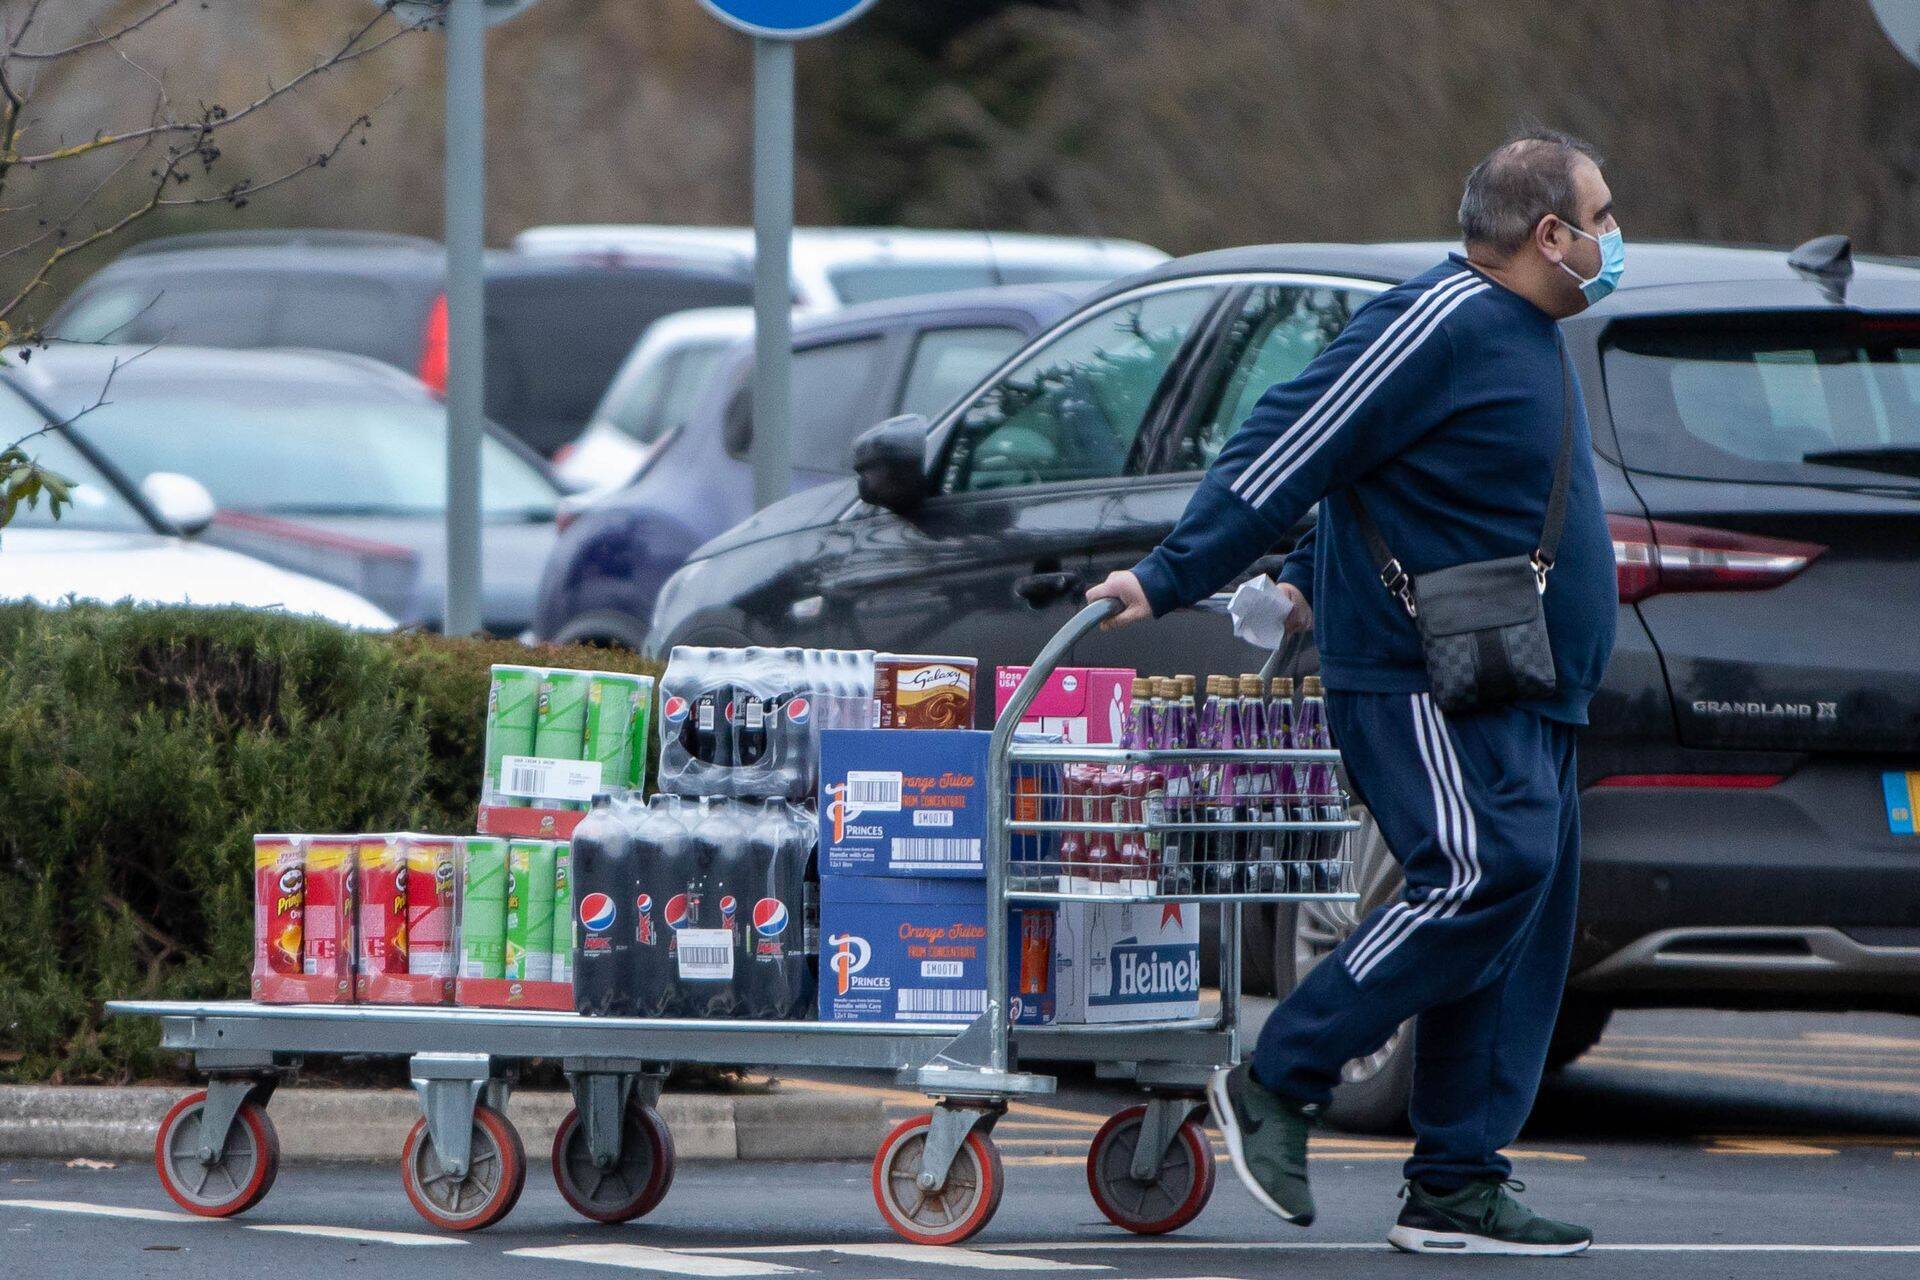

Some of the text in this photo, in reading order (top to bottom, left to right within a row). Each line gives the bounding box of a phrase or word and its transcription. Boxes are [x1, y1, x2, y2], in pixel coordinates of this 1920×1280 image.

[912, 667, 961, 688] Galaxy
[1692, 701, 1838, 718] GRANDLAND X
[902, 771, 975, 794] range Juice
[918, 812, 949, 824] SMOOTH
[846, 825, 884, 836] PRINCES
[277, 890, 303, 916] Pring
[899, 921, 985, 944] Orange Juice
[926, 963, 959, 975] SMOOTH
[851, 976, 891, 987] PRINCES
